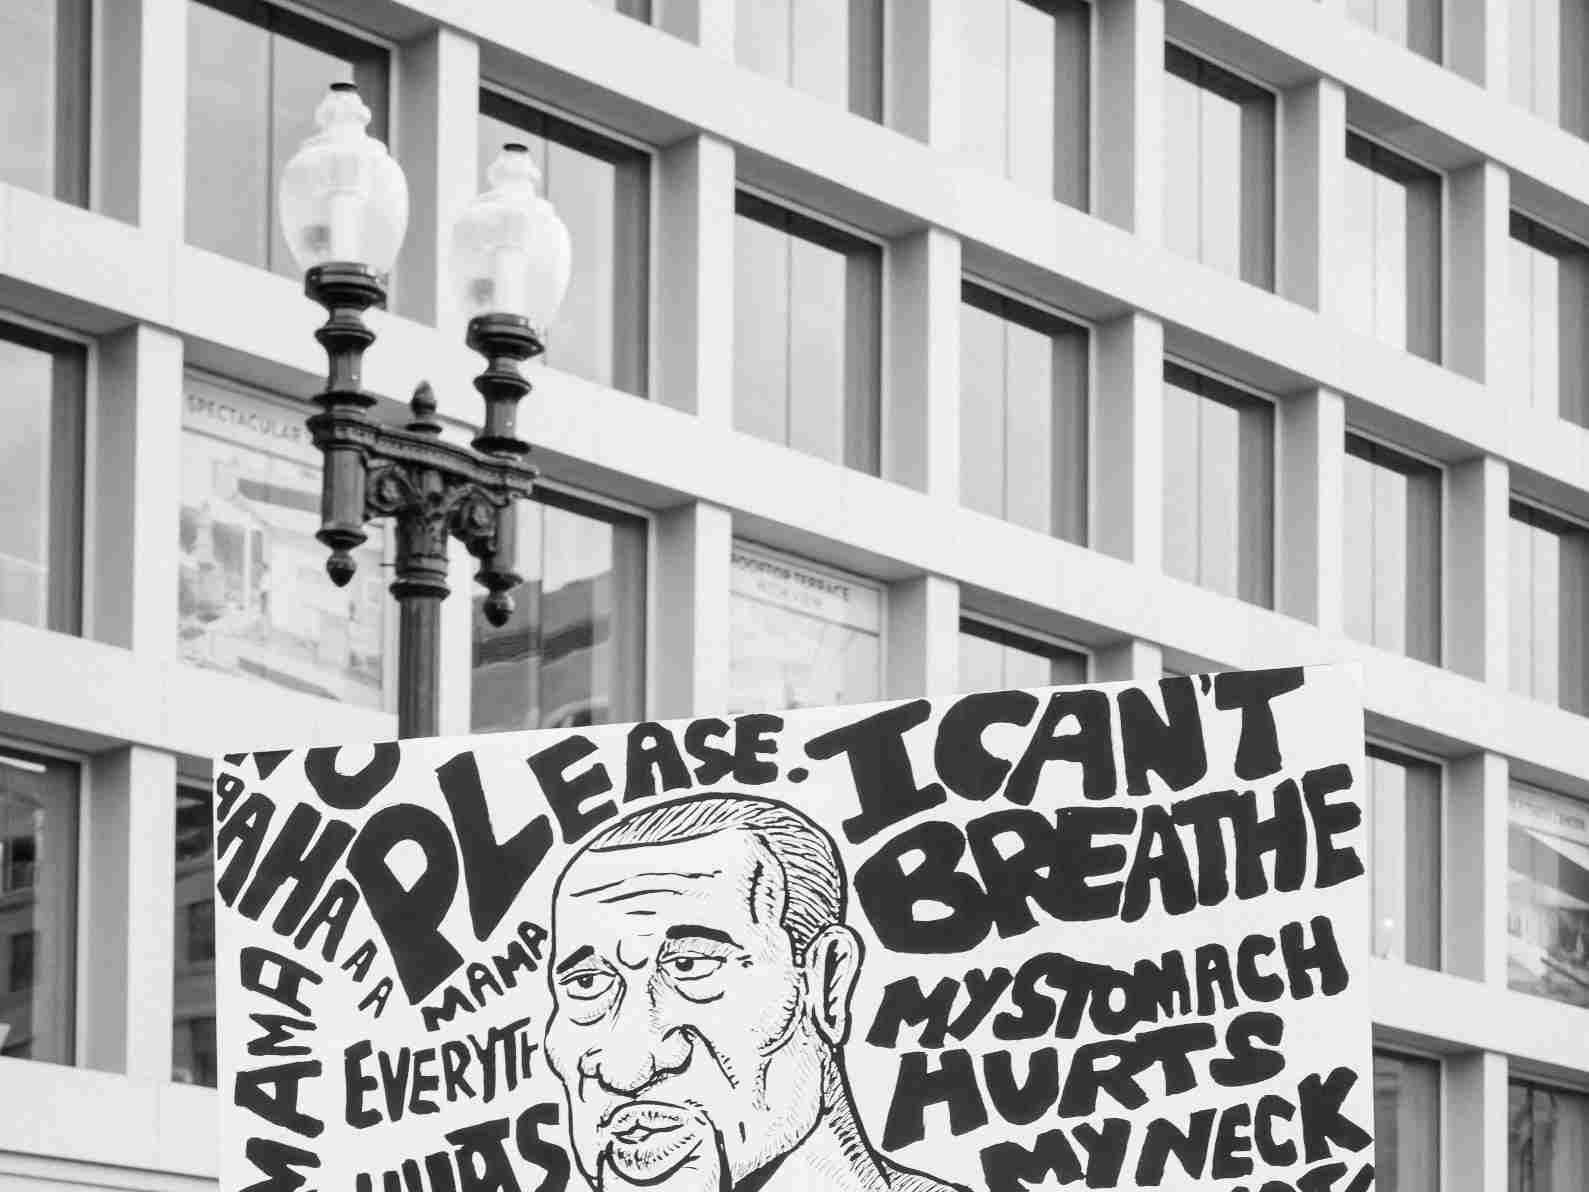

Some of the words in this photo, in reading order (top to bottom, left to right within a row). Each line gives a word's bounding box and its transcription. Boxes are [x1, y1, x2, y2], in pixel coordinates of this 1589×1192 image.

[853, 763, 1365, 954] BREATHE
[422, 920, 548, 1032] MAMA
[882, 1012, 1285, 1151] HURTS
